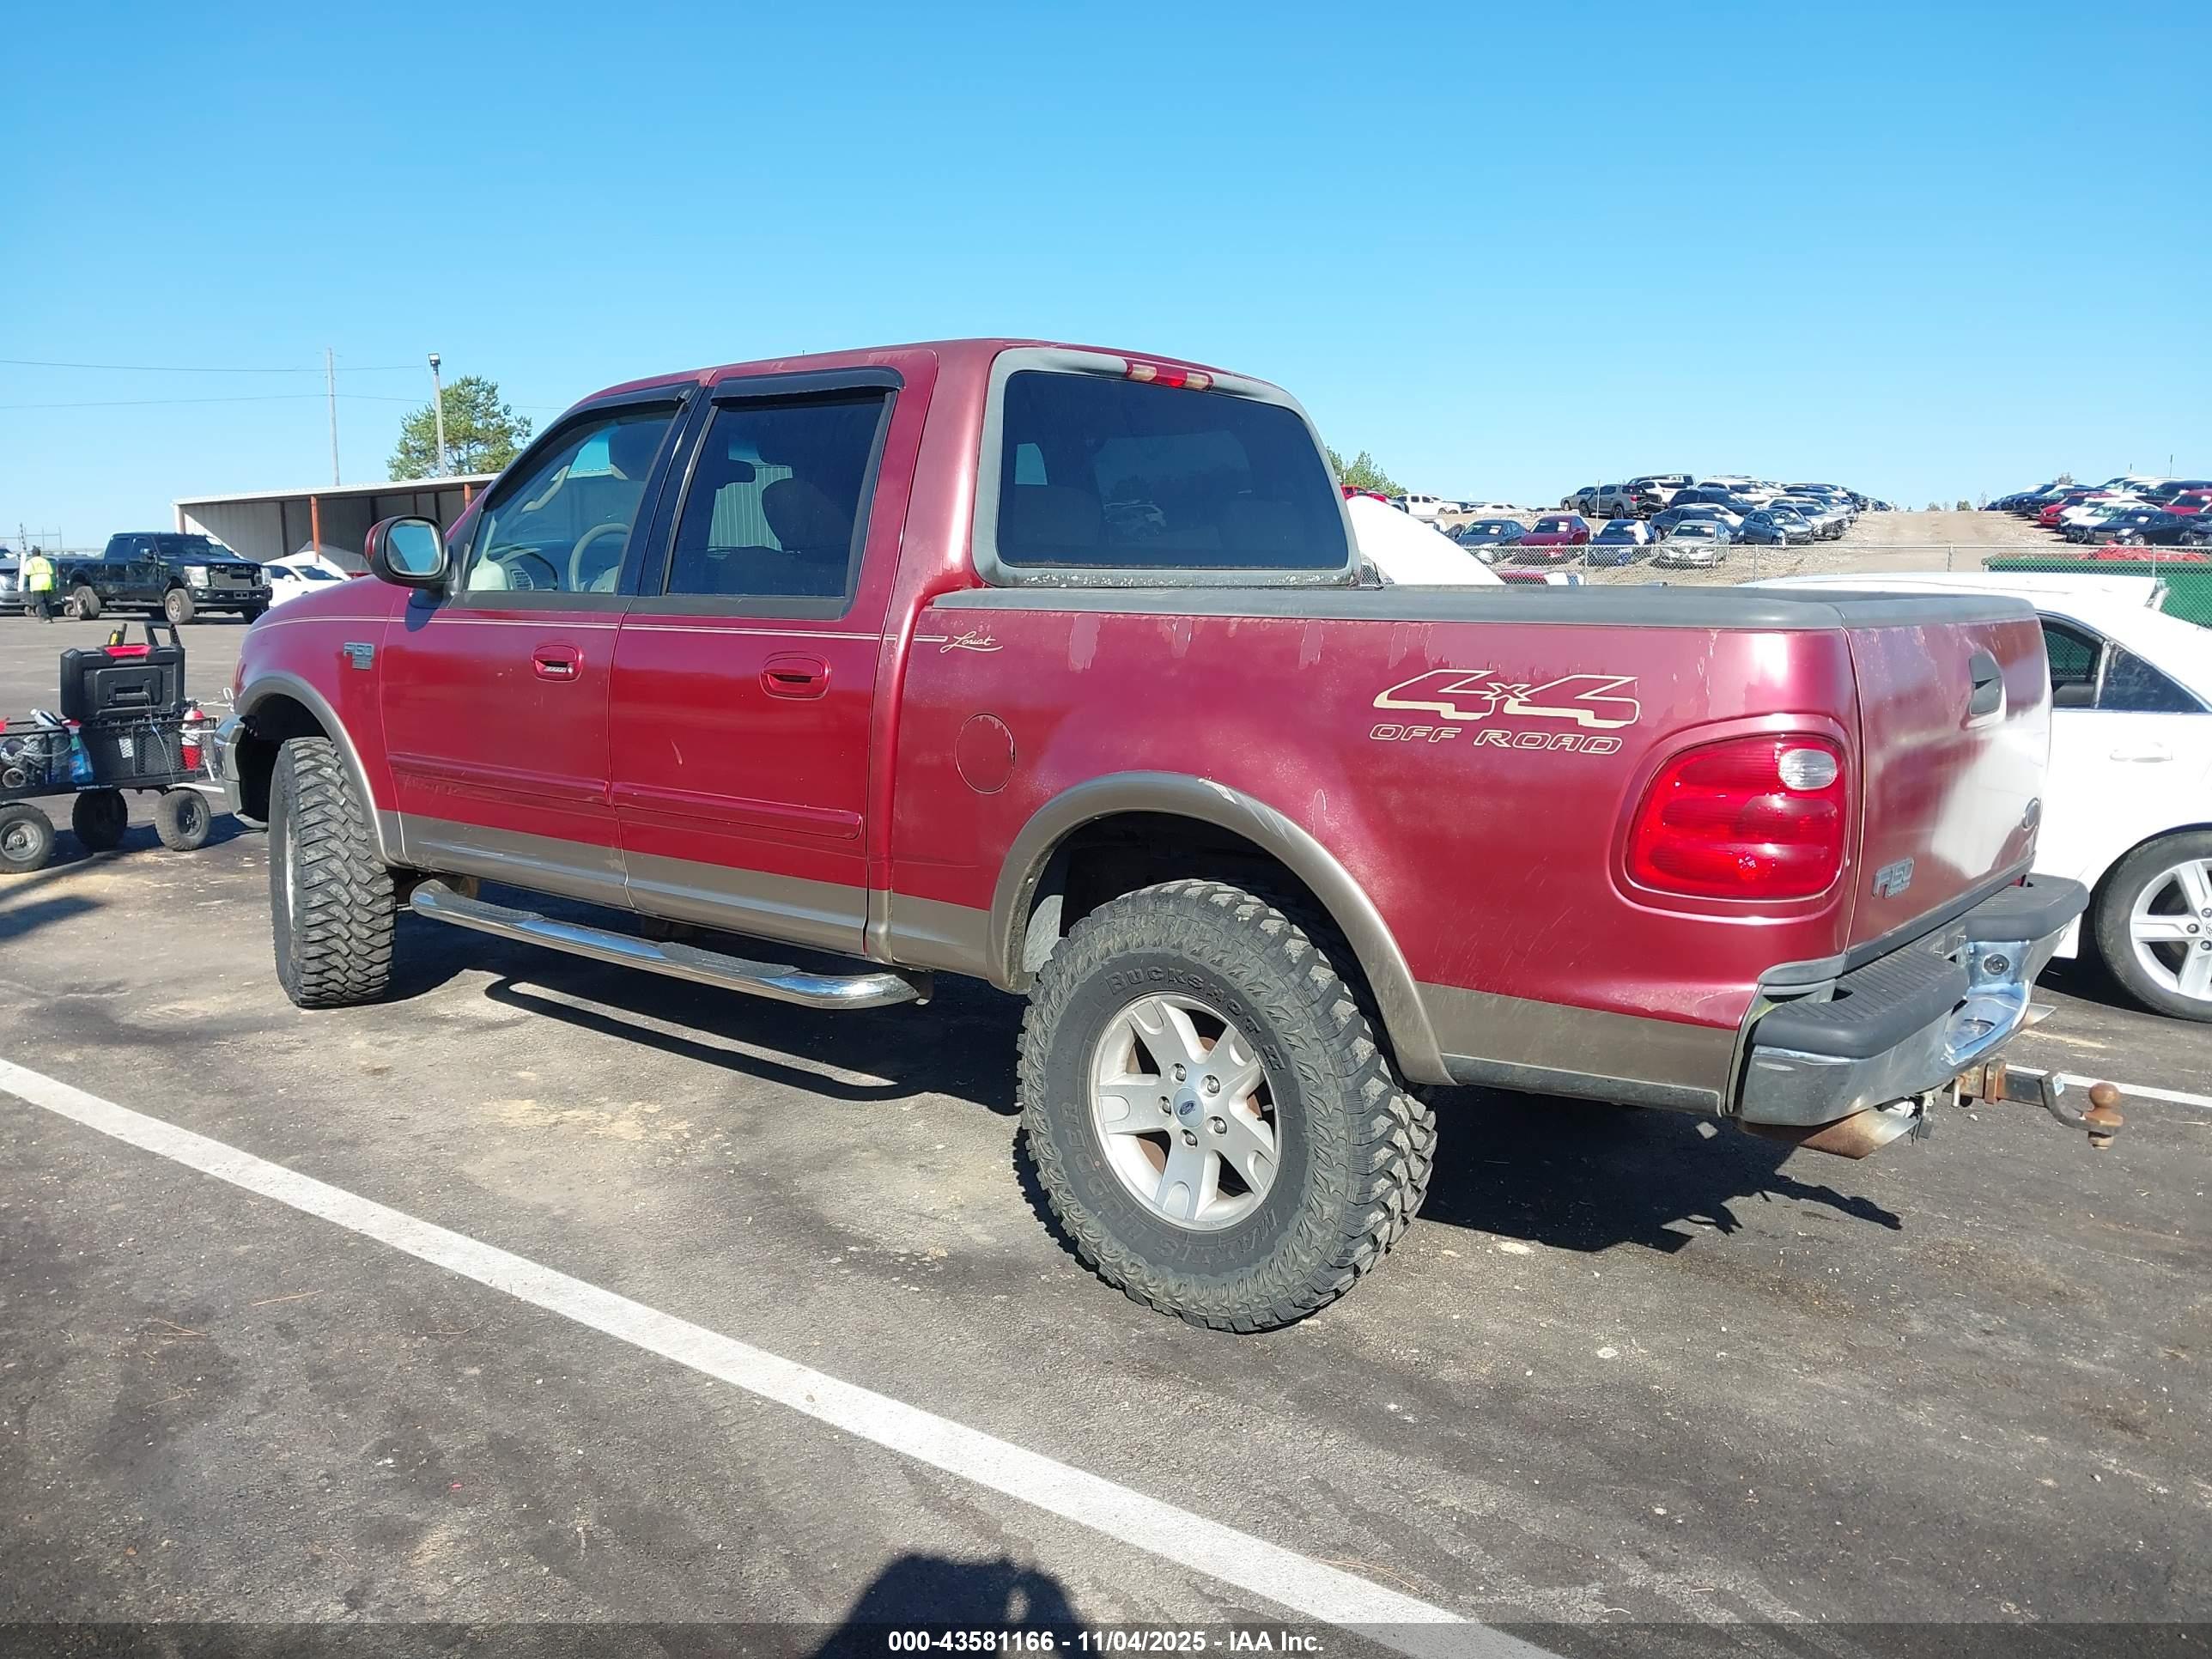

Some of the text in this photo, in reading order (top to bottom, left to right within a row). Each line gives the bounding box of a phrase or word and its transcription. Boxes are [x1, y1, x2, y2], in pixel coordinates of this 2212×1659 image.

[1369, 724, 1624, 756] OFF ROAD
[1104, 965, 1261, 1036] BUCKSHOT
